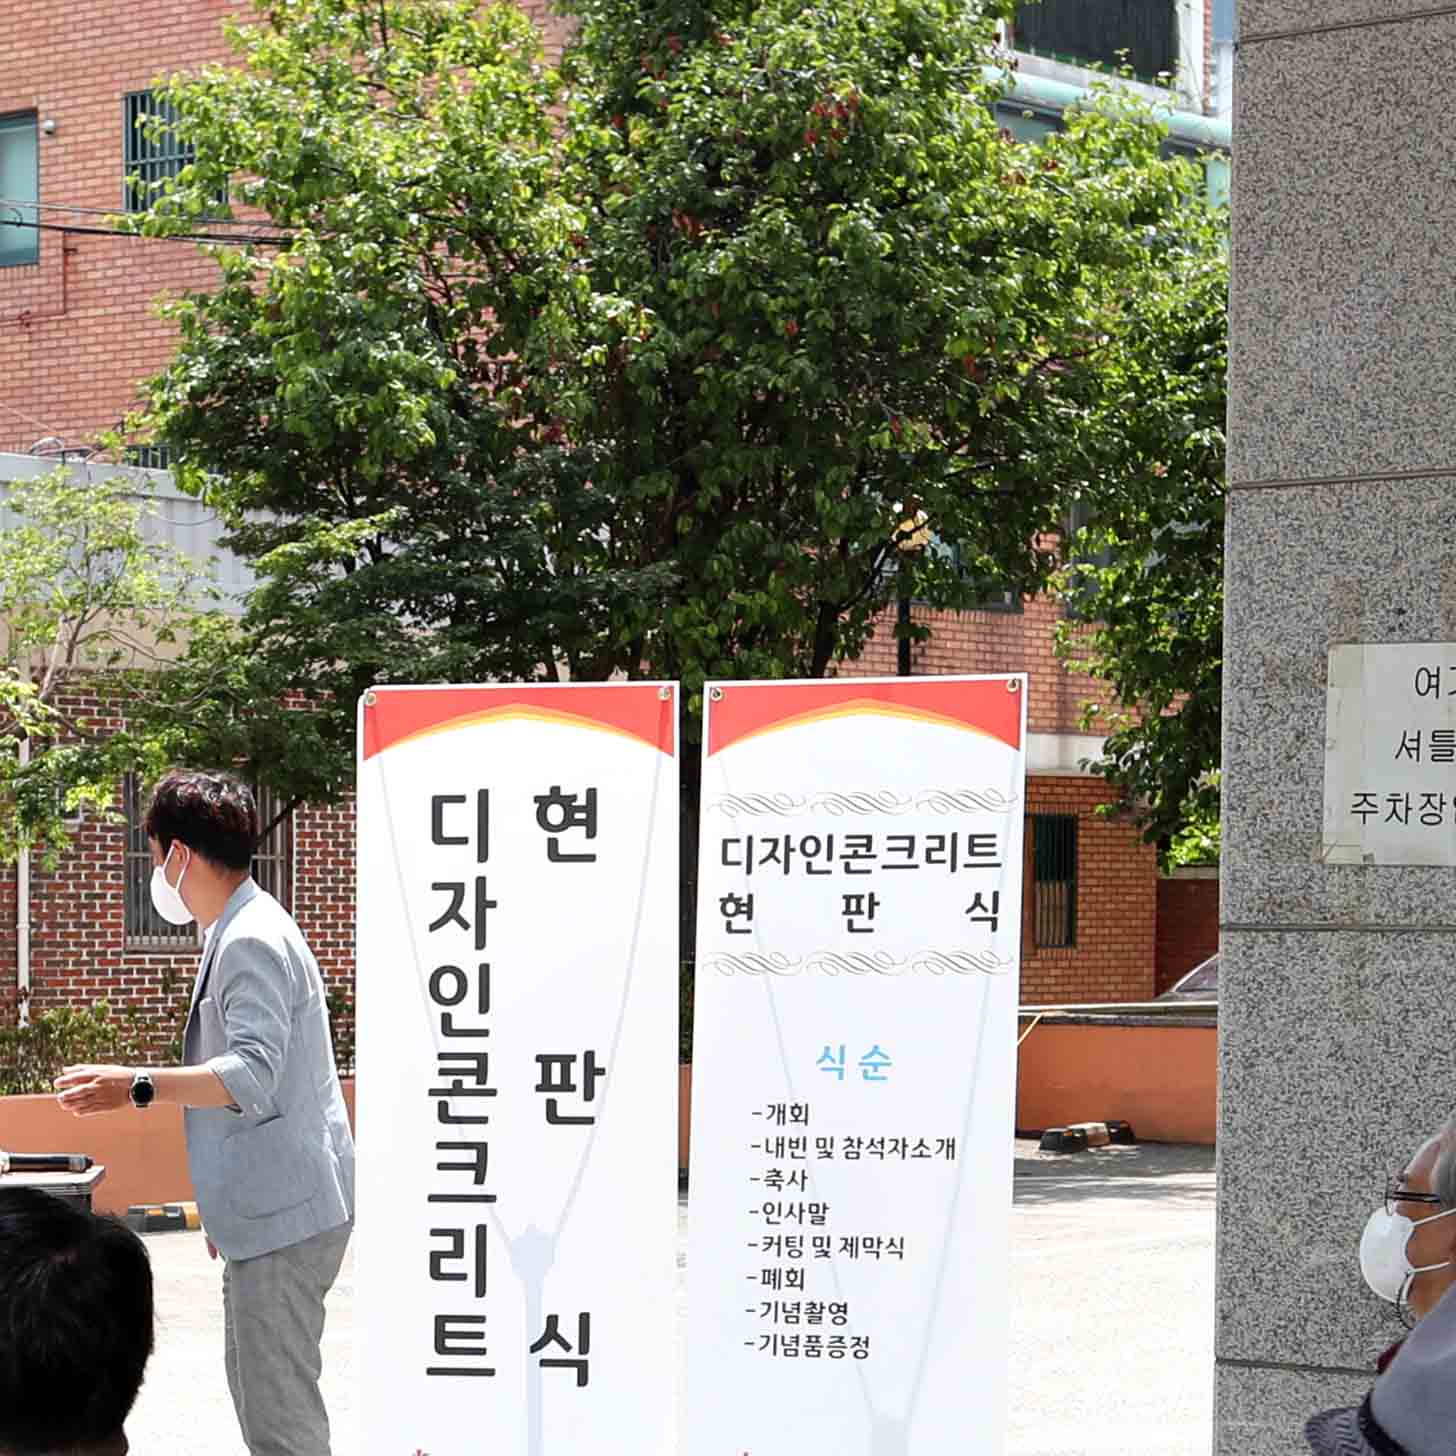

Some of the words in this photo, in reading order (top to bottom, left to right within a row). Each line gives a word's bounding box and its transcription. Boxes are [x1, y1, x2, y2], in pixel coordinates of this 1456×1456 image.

[721, 832, 1002, 876] 디자인콘크리트
[426, 788, 498, 1377] 디자인콘크리트
[815, 1136, 835, 1160] 및
[842, 1136, 957, 1161] 참석자소개
[812, 1235, 832, 1259] 및
[838, 1236, 906, 1261] 제막식
